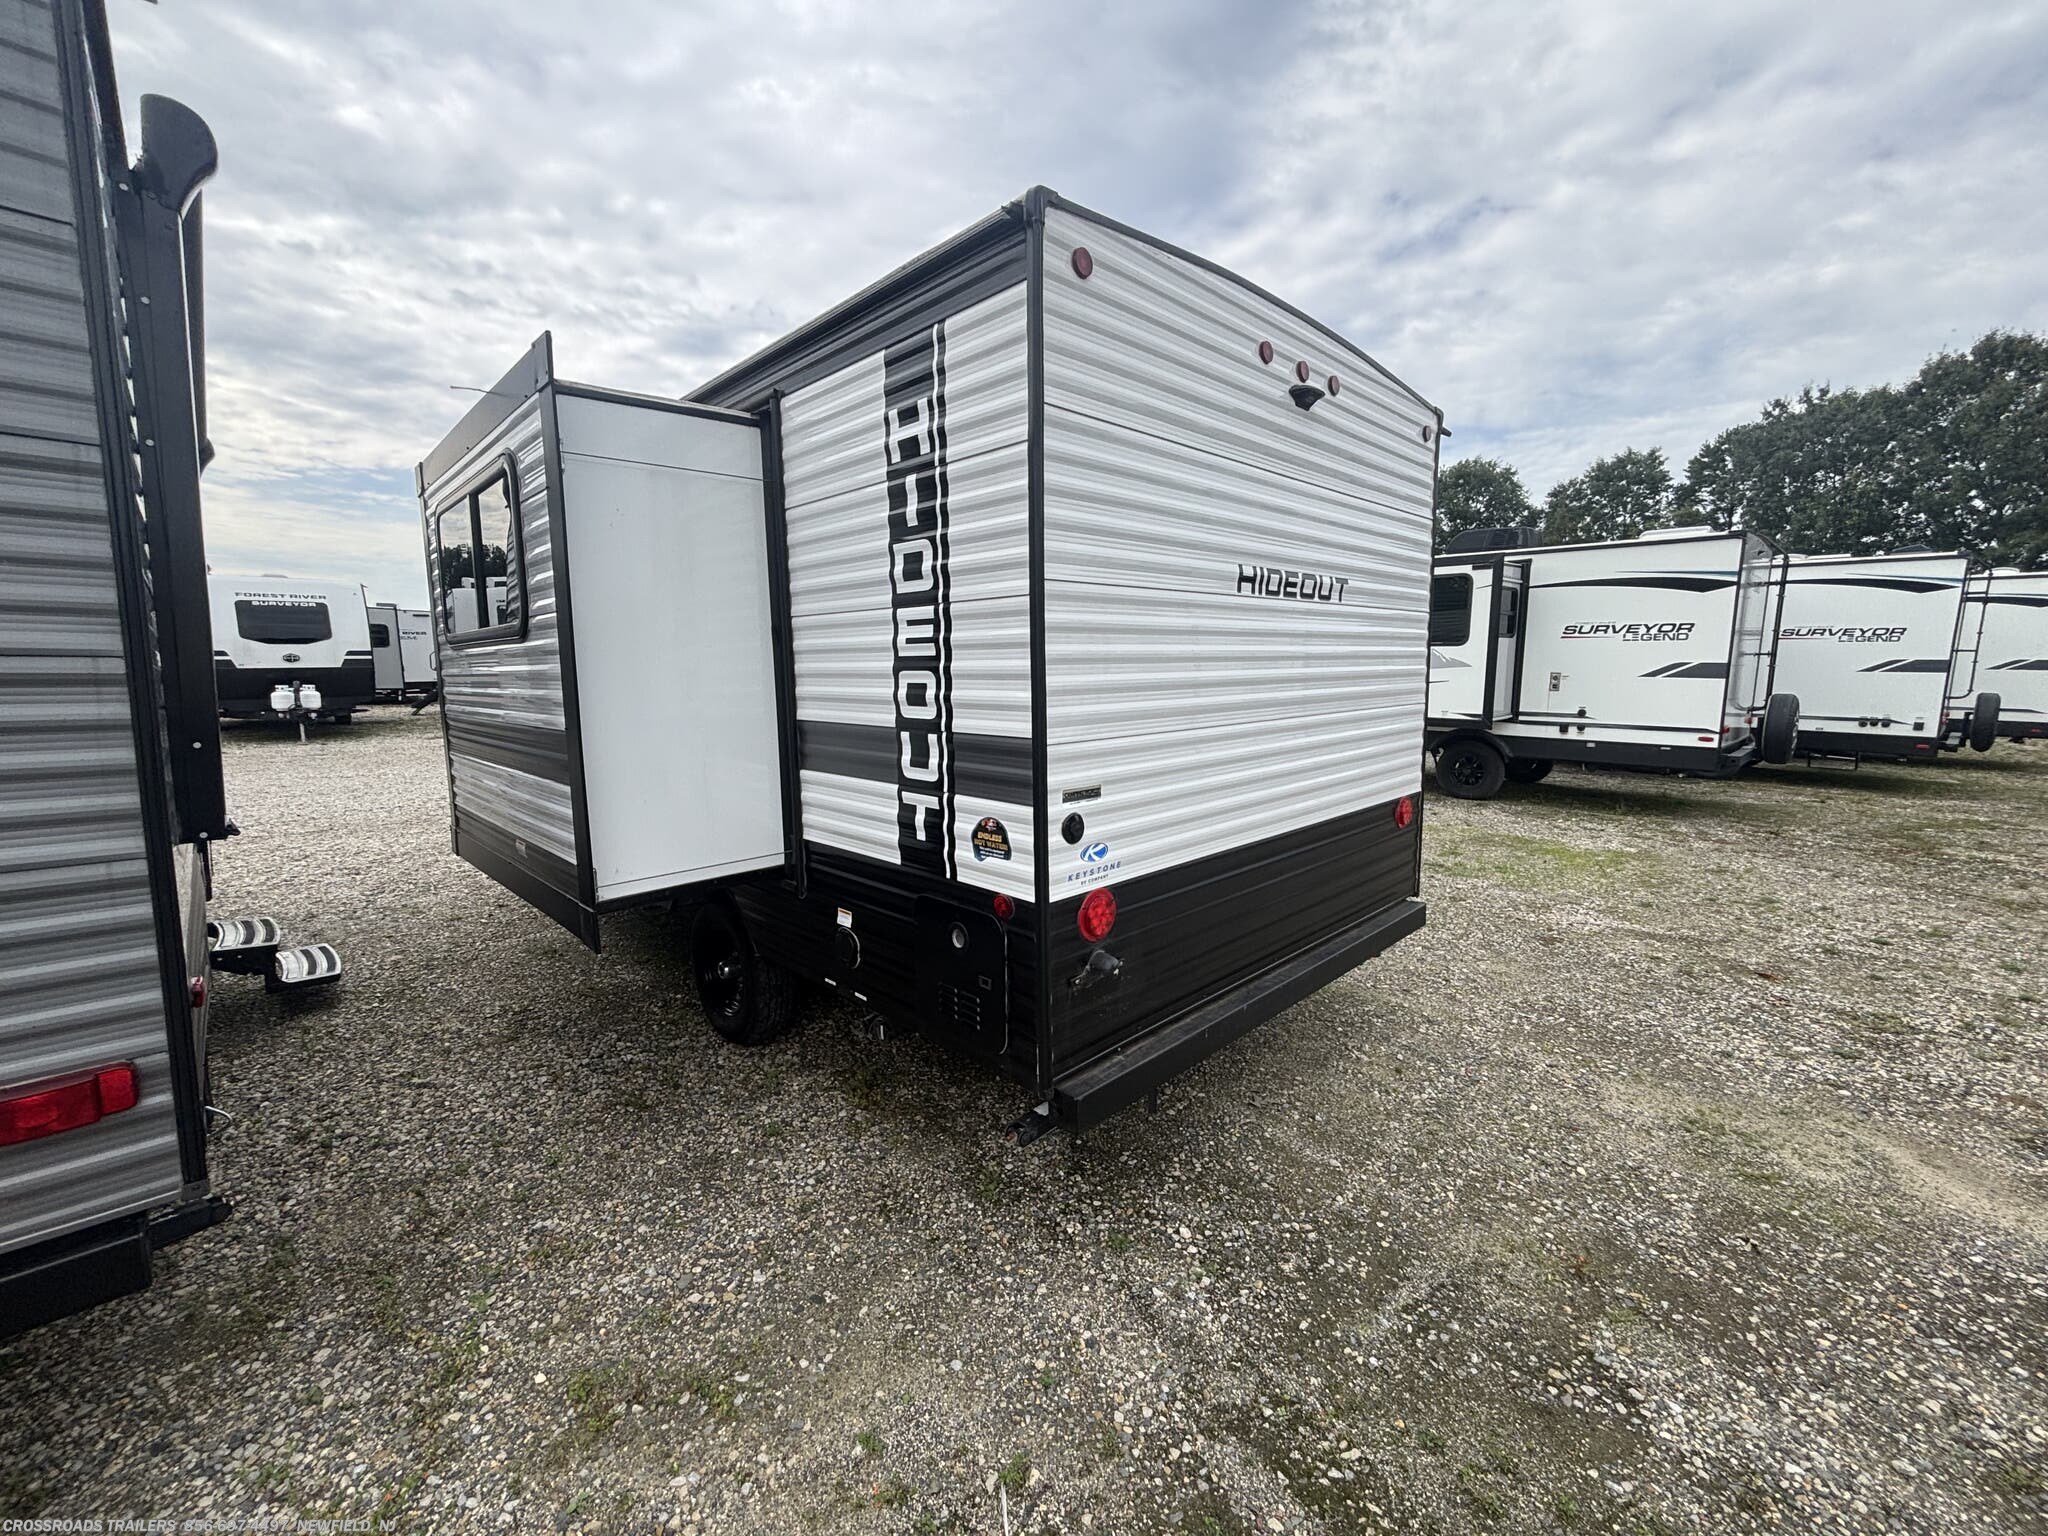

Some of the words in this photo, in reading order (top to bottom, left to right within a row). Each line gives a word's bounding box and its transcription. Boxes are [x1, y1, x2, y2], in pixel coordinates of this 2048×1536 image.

[1237, 563, 1349, 602] HIDEOUT
[887, 397, 940, 842] HIDEOUT
[1562, 623, 1696, 635] SURVEYOR
[1780, 628, 1907, 637] SURVEYOR
[1622, 632, 1689, 641] LEGEND
[1838, 635, 1901, 643] LEGEND
[1067, 861, 1121, 882] KEYSTONE
